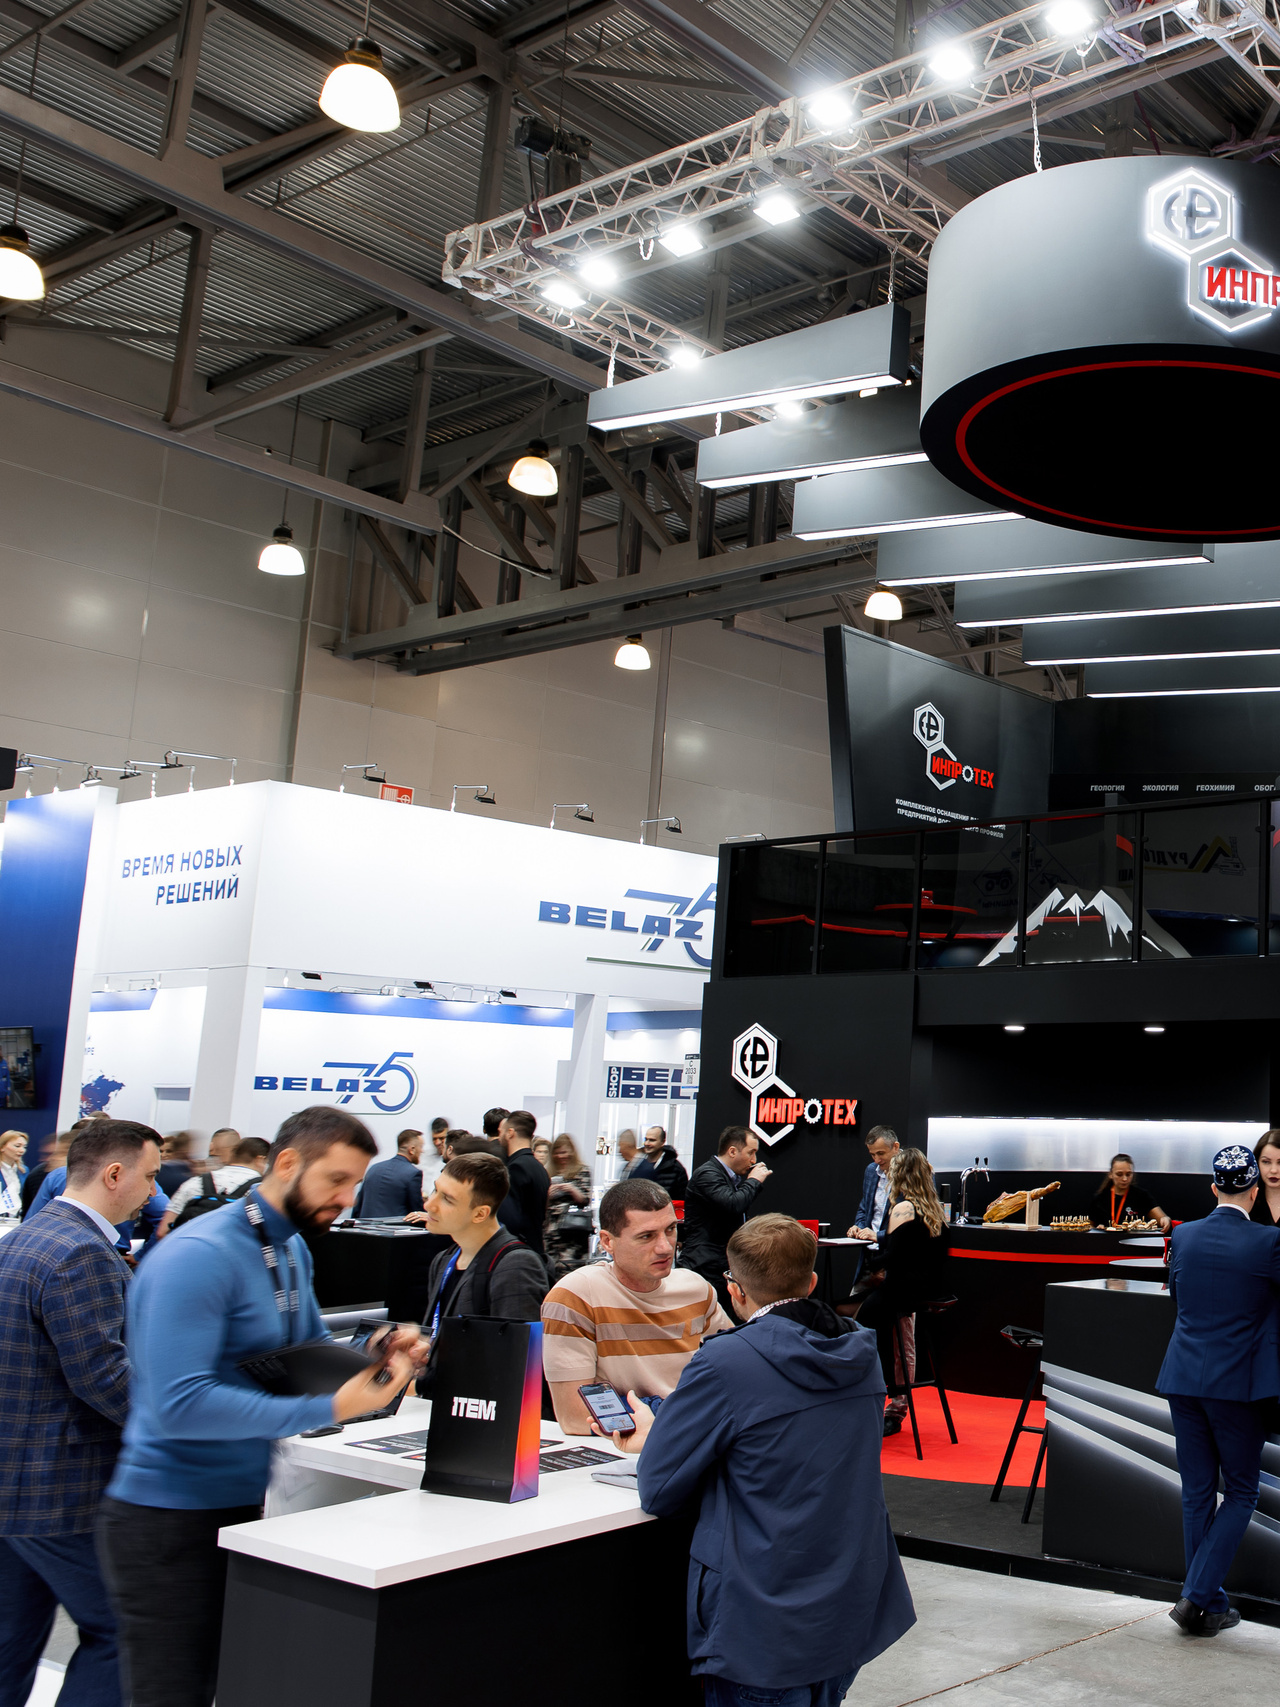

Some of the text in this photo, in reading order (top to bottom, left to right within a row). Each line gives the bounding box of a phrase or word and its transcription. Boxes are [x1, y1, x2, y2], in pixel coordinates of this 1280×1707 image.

[1090, 784, 1125, 792] ГЕОЛОГИЯ
[1142, 784, 1179, 792] ЭКОЛОГИЯ
[1196, 784, 1235, 792] ГЕОХИМИЯ
[1254, 784, 1277, 792] ОБОГ
[895, 798, 936, 814] КОМПЛЕКСНОЕ
[896, 808, 937, 824] ПРЕДПРИЯТИЙ
[122, 845, 243, 878] ВРЕМЯ НОВЫХ
[156, 873, 239, 905] РЕШЕНИЙ
[538, 901, 704, 941] BELAZ
[685, 1067, 696, 1075] 2033
[254, 1076, 387, 1093] BELAZ
[608, 1066, 620, 1098] SHOP
[451, 1396, 497, 1421] ITEM
